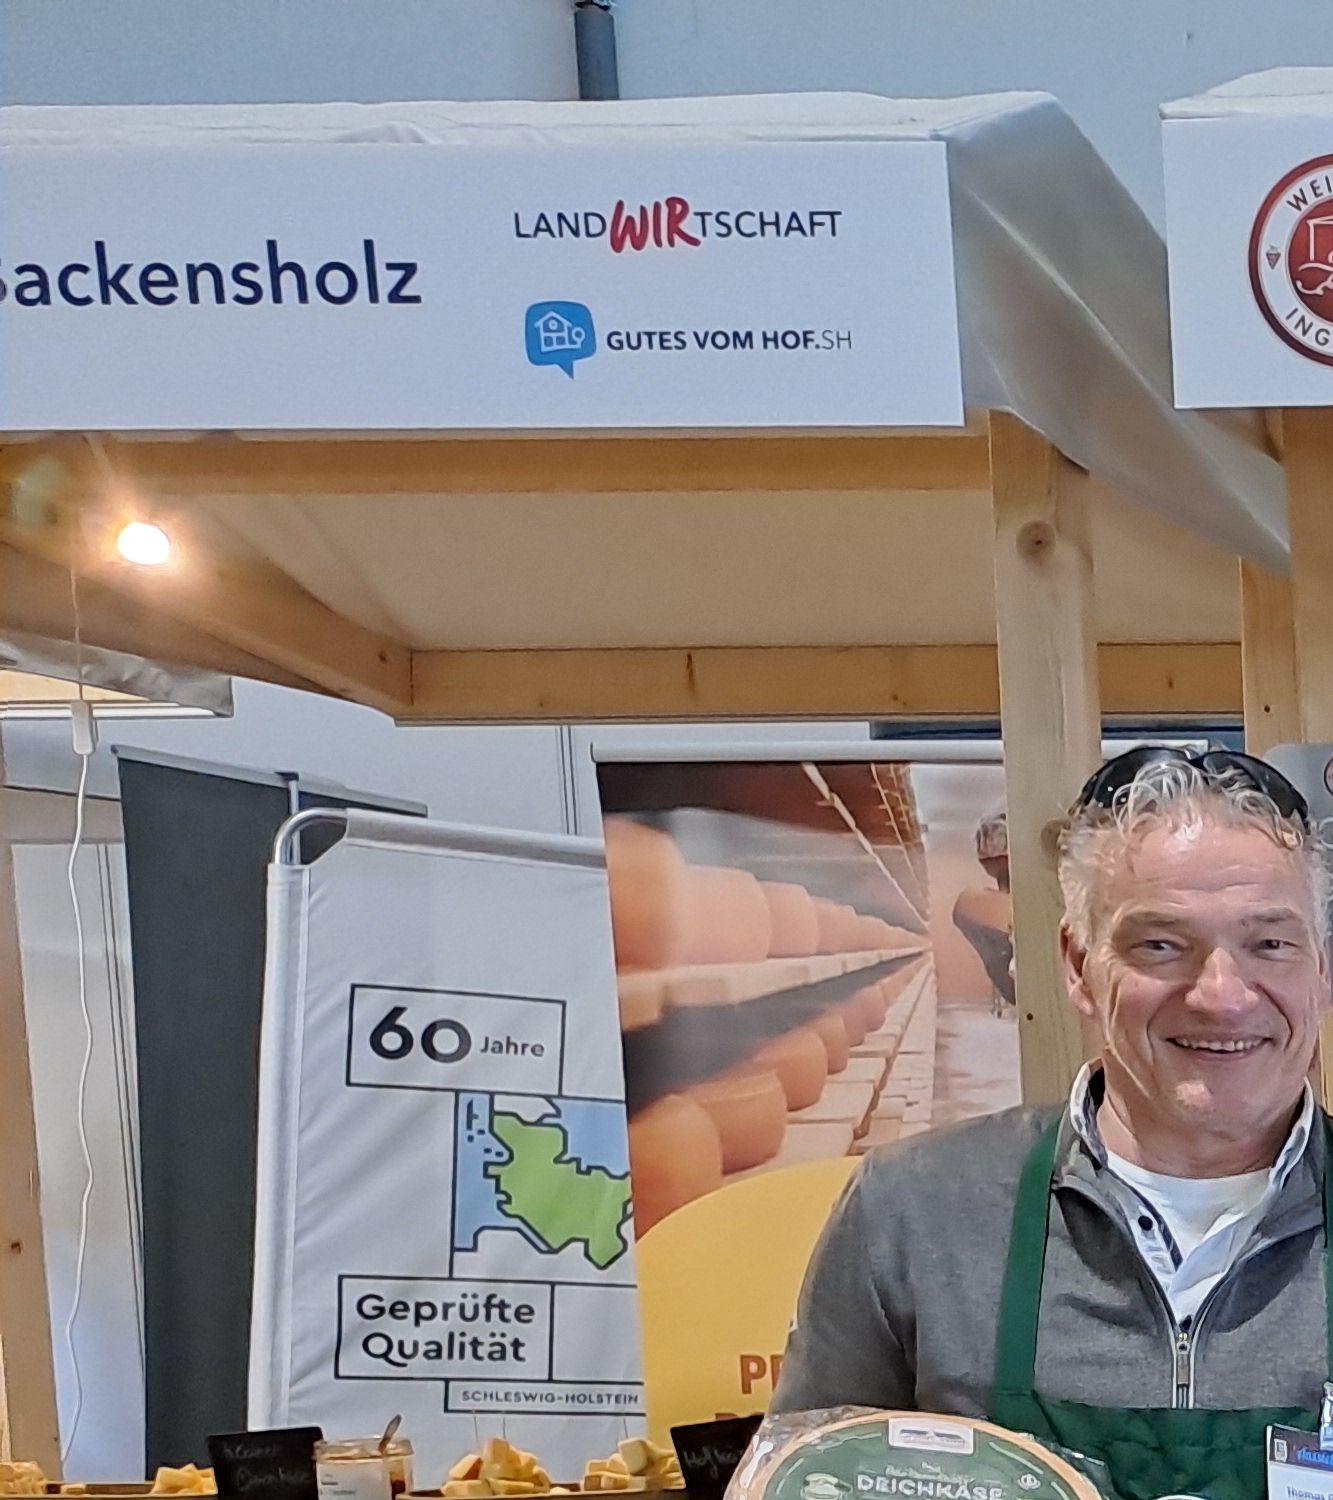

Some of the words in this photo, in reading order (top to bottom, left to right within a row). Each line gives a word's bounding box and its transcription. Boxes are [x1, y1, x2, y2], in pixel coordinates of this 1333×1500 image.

[513, 197, 842, 254] LANDWIRTSCHAFT
[606, 329, 688, 352] GUTES
[694, 329, 755, 351] VOM
[761, 330, 853, 352] HOF.SH
[369, 1006, 472, 1064] 60
[479, 1035, 545, 1058] Jahre
[355, 1292, 535, 1328] Geprüfte
[361, 1331, 527, 1368] Qualität
[461, 1389, 640, 1405] SCHLESWIG-HOLSTEIN
